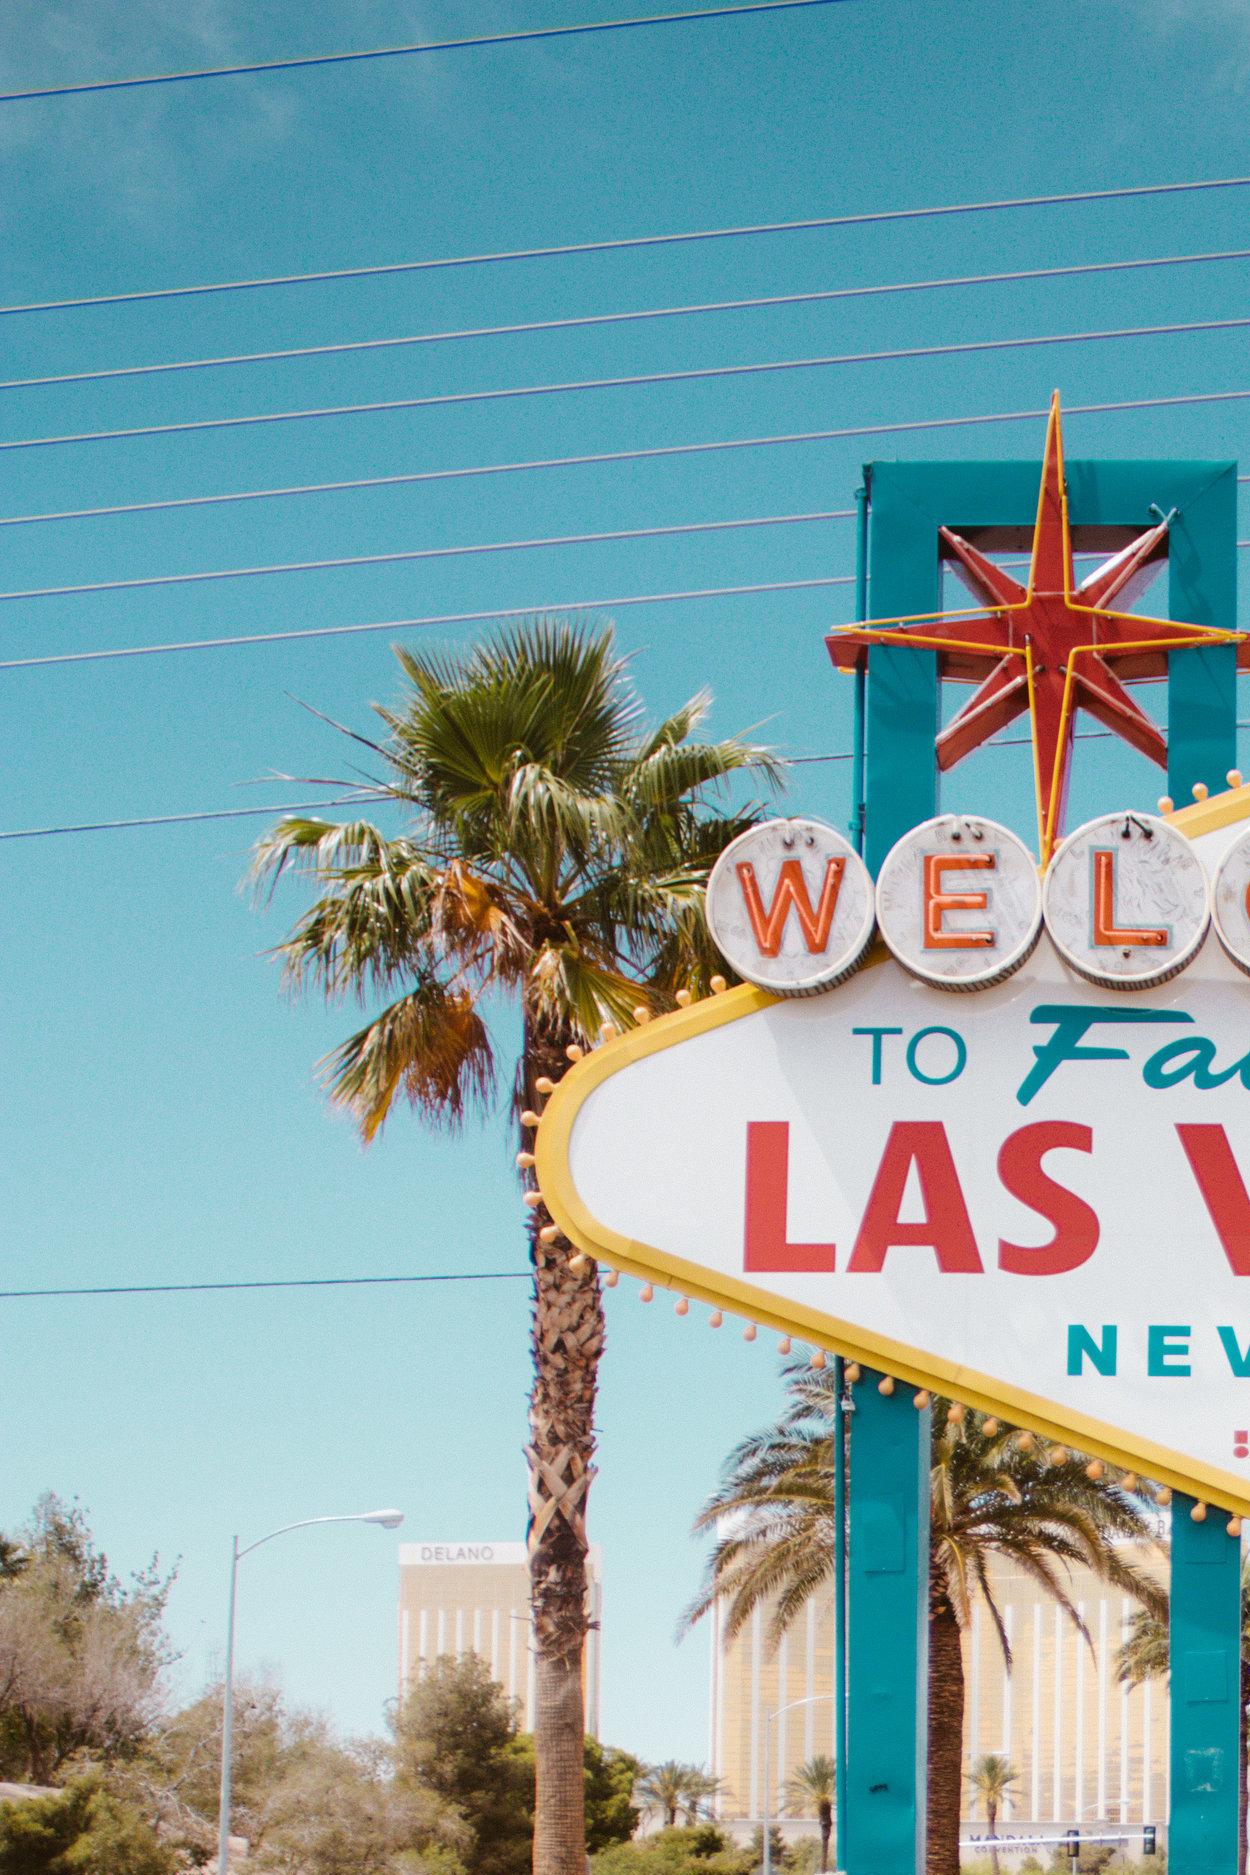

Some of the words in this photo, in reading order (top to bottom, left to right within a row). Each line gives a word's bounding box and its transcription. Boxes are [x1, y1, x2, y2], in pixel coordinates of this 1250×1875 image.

[853, 1025, 968, 1086] TO
[742, 1119, 1101, 1276] LAS
[420, 1545, 495, 1562] DELANO
